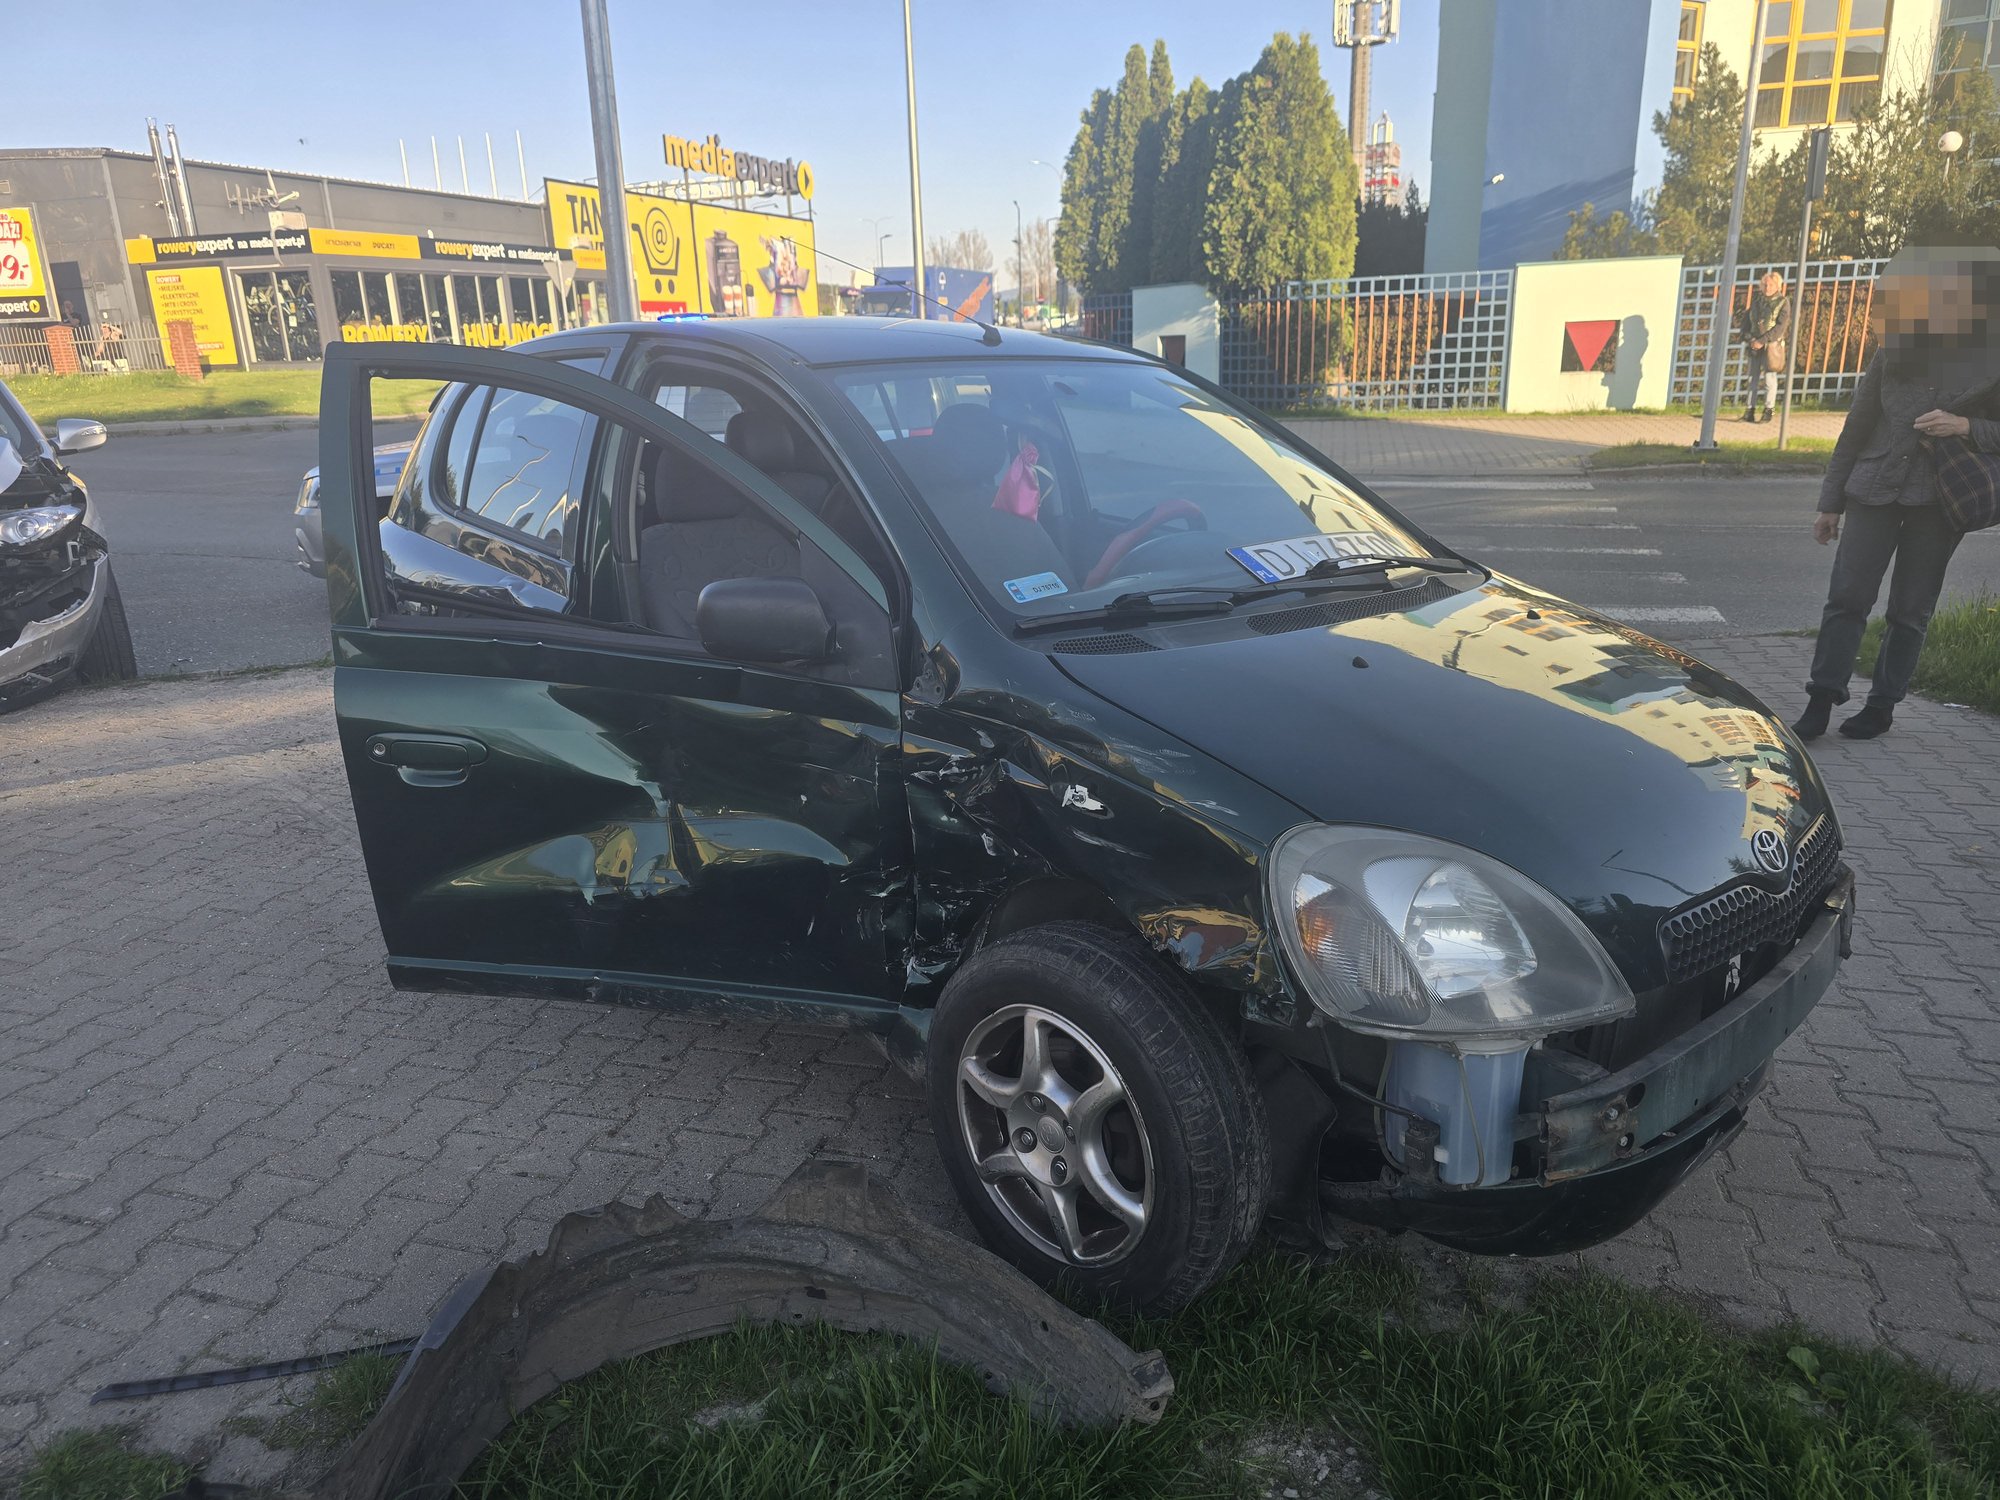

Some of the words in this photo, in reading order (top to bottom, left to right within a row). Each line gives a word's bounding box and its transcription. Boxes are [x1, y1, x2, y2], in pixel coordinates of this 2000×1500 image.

[663, 134, 797, 194] mediaexpert
[157, 237, 234, 255] roweryexpert
[237, 240, 248, 249] na
[249, 235, 305, 249] mediaxpert.pl
[435, 241, 506, 260] roweryexpert
[508, 249, 517, 259] na
[341, 324, 428, 343] ROWERY
